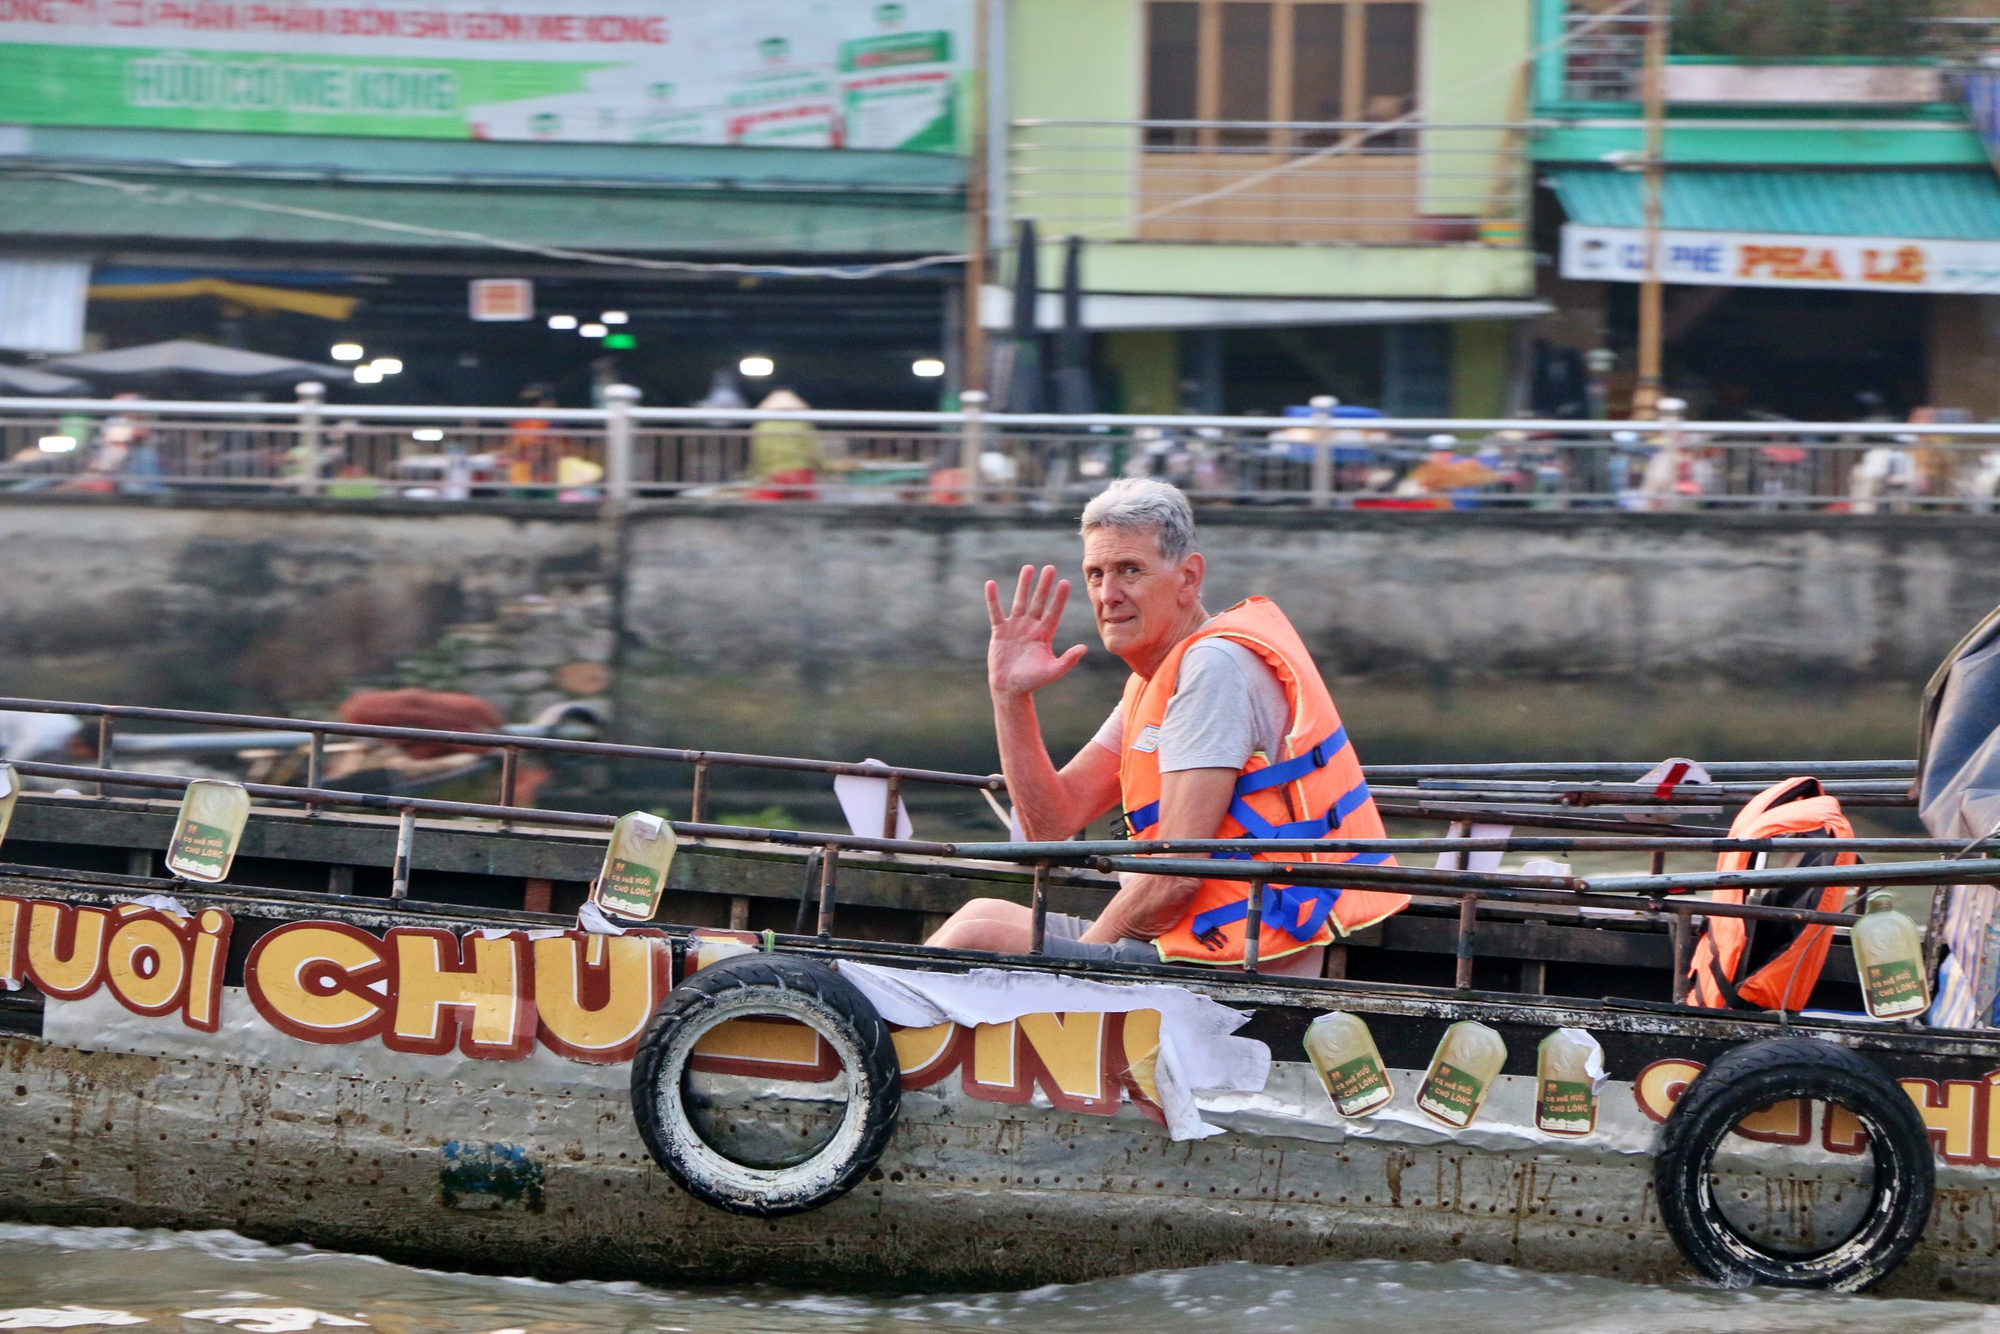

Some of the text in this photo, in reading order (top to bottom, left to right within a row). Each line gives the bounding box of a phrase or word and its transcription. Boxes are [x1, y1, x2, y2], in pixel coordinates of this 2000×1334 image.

[201, 849, 224, 859] LONG
[630, 887, 652, 898] LONG
[1896, 980, 1918, 994] LONG
[1358, 1073, 1379, 1090] LONG
[1450, 1093, 1472, 1106] LONG
[1567, 1104, 1588, 1114] LONG
